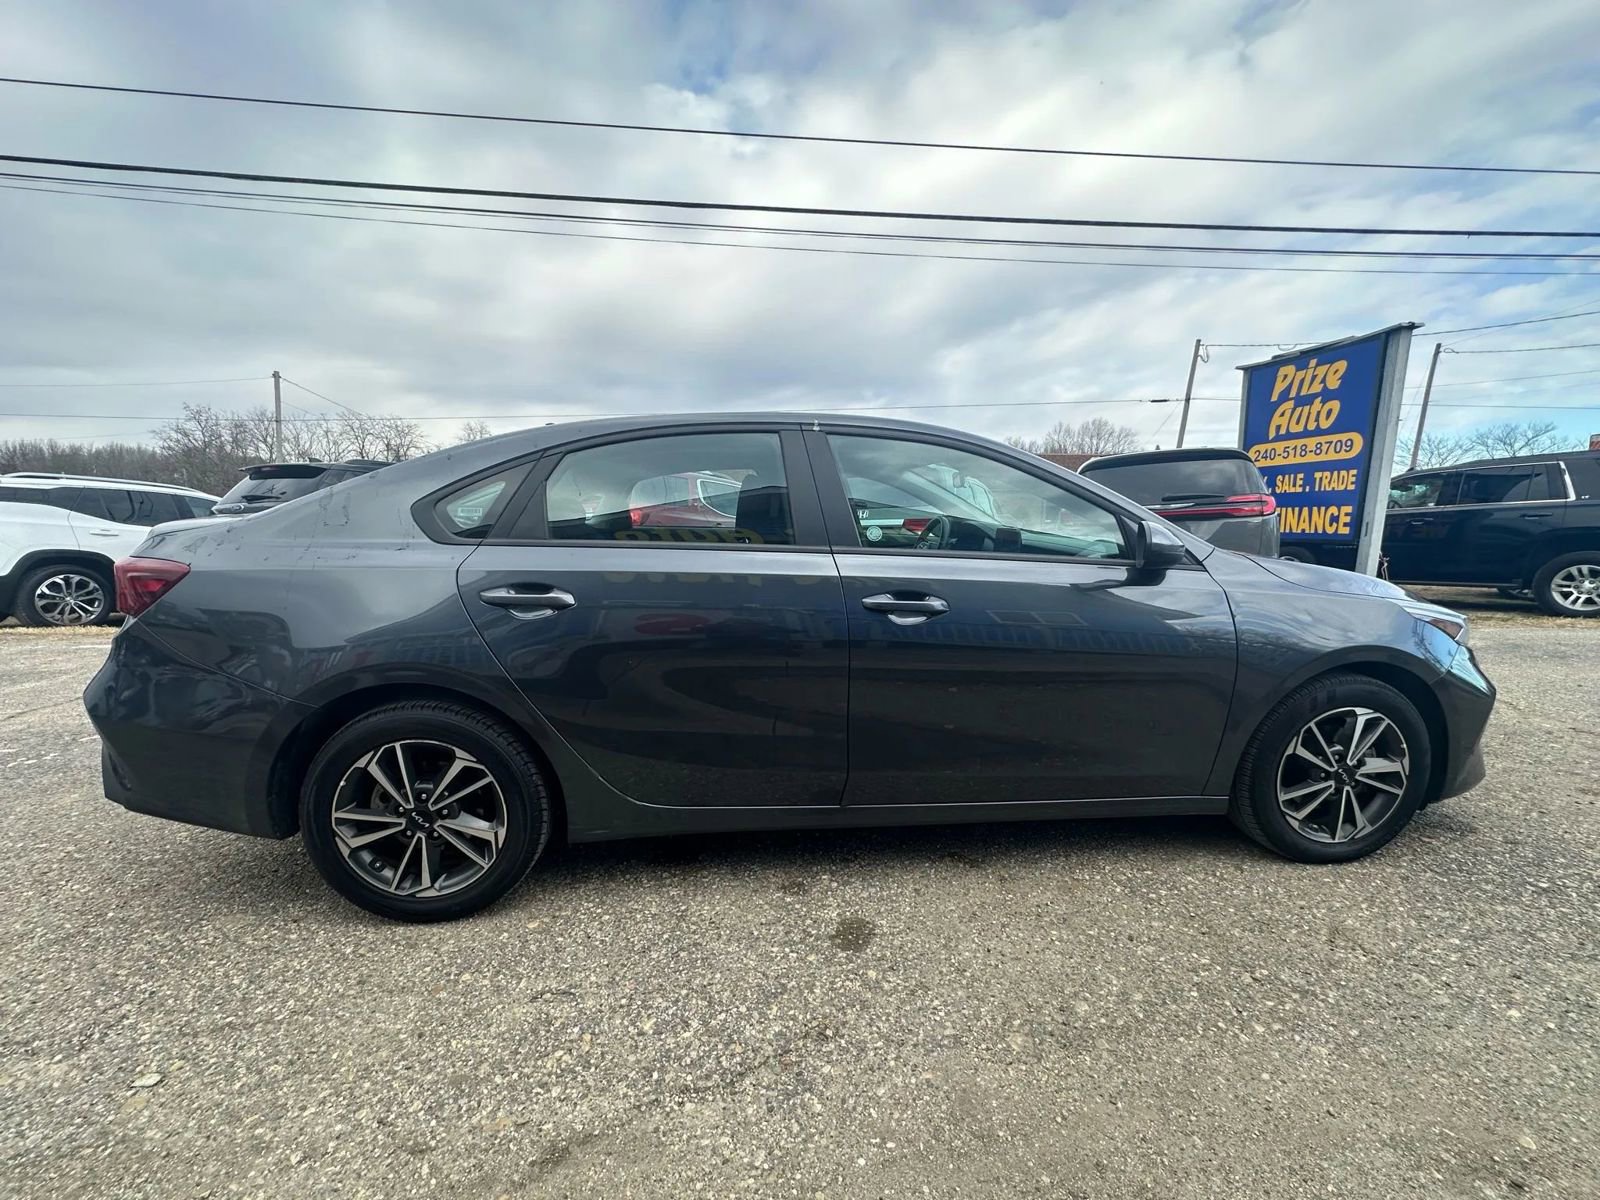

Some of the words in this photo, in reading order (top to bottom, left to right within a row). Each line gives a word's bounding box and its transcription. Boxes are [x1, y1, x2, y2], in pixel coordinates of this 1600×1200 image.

[1270, 358, 1348, 402] Prize
[1268, 396, 1341, 440] Auto
[1254, 438, 1354, 463] 240-518-8709
[1314, 469, 1358, 492] TRADE
